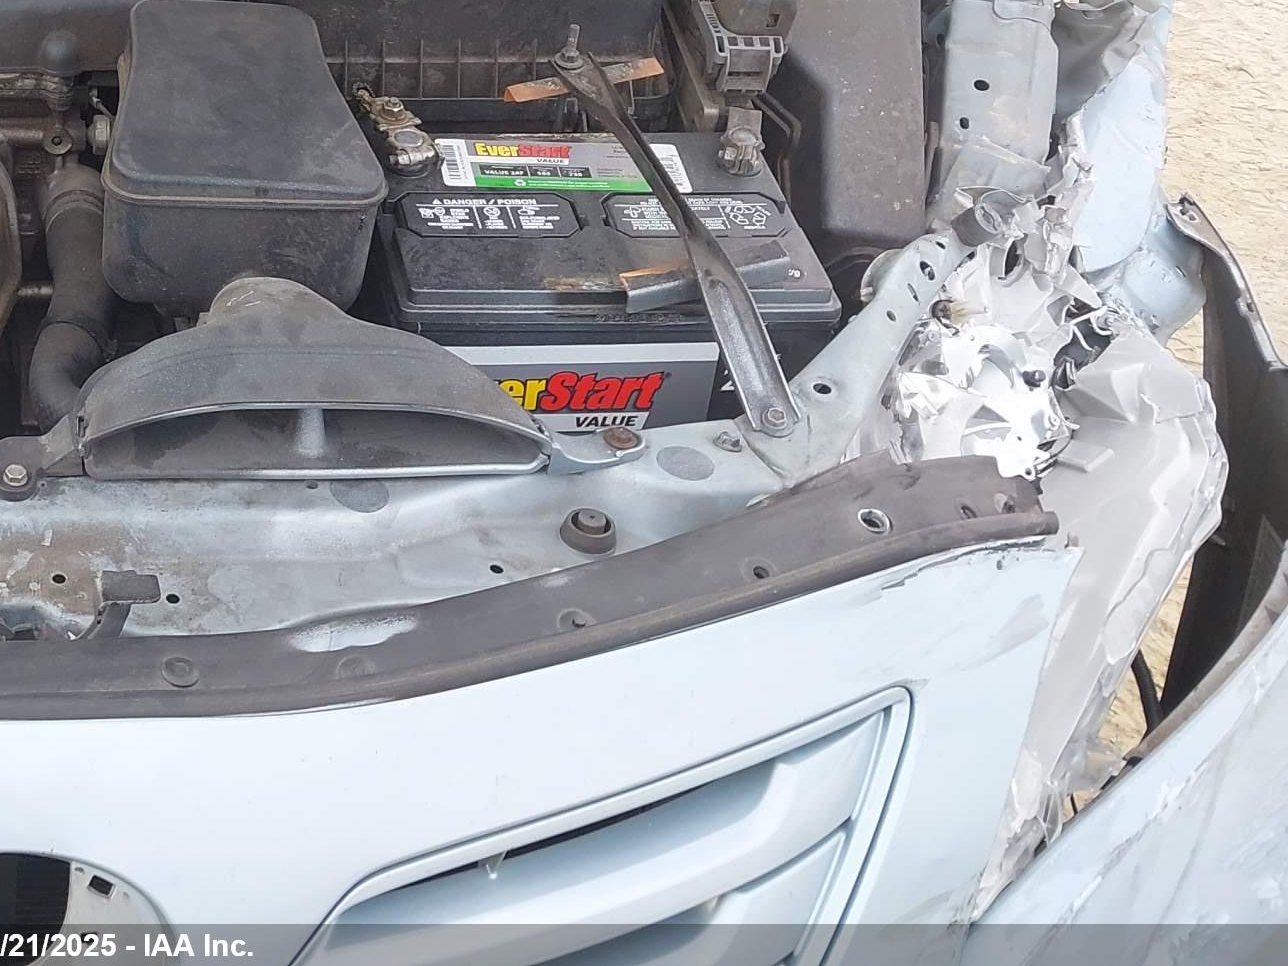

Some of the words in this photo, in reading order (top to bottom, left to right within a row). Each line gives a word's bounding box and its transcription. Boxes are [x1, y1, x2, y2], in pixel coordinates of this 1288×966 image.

[474, 142, 569, 158] EverStart
[498, 370, 666, 412] erStart
[575, 416, 639, 428] VALUE
